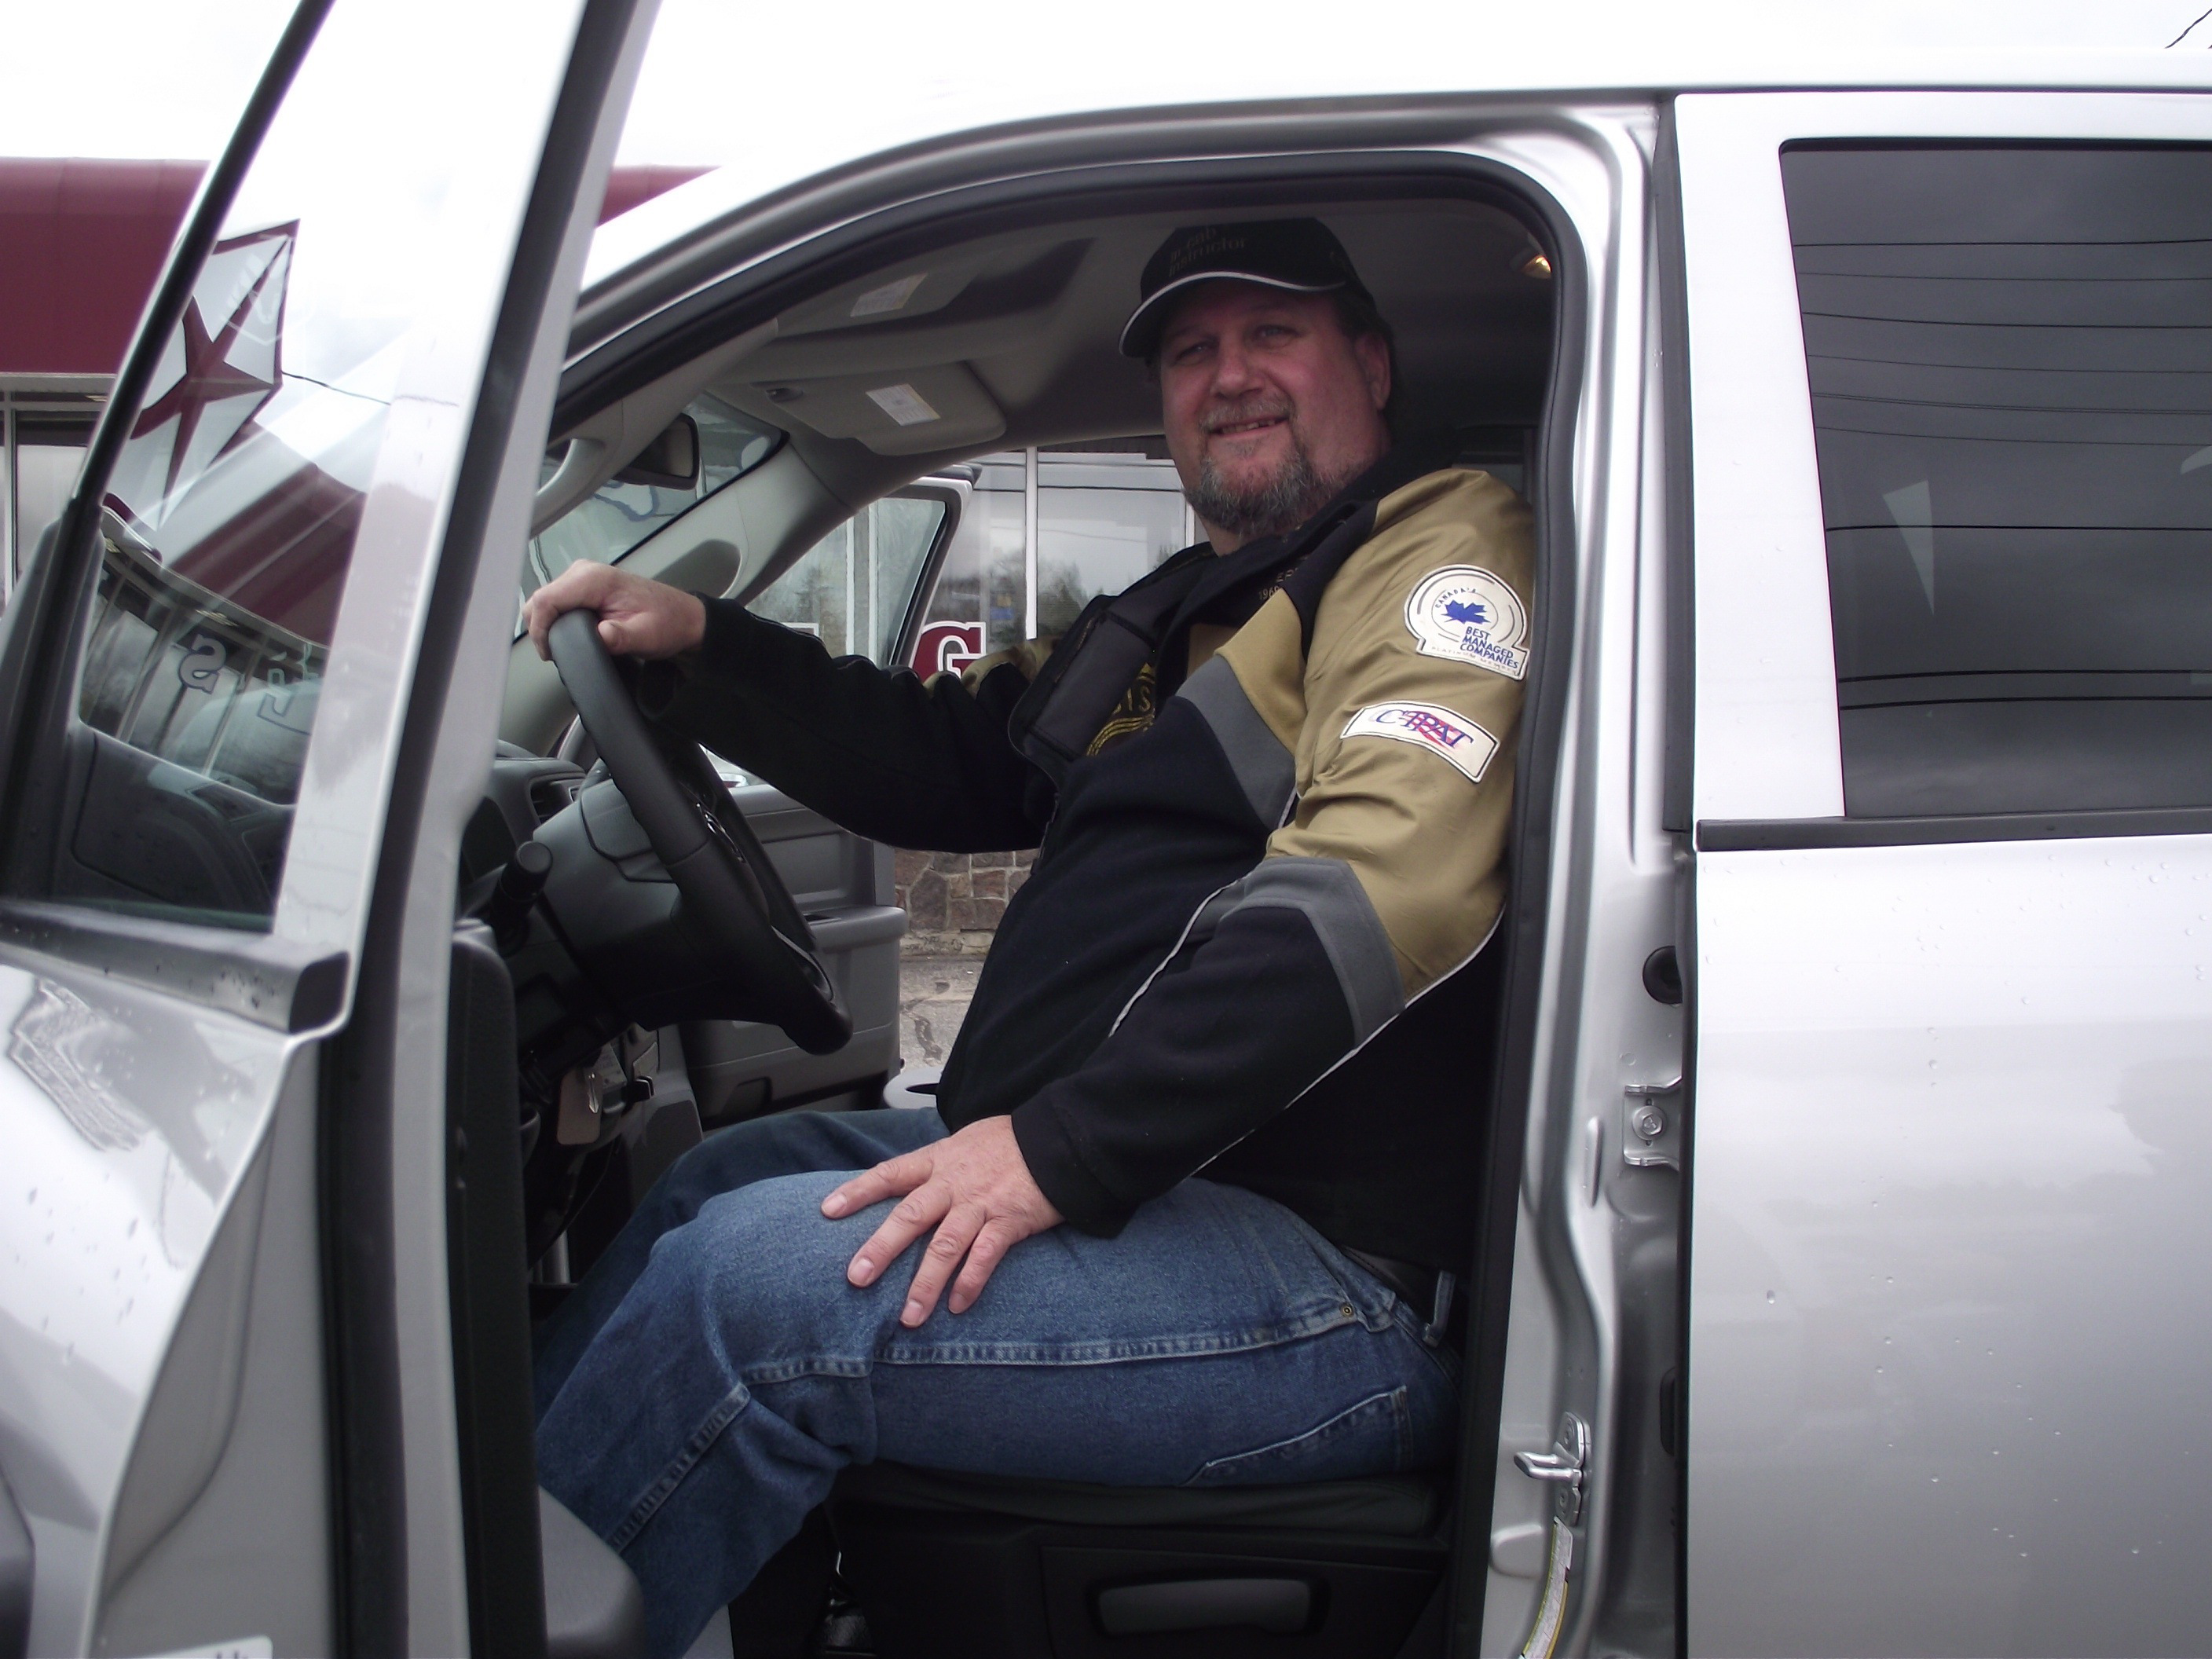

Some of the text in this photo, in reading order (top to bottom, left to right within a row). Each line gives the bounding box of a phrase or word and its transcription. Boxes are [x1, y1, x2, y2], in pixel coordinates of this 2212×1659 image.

[1466, 626, 1491, 640] BEST
[1459, 643, 1519, 669] COMPANIES
[1462, 635, 1514, 658] MANAGED
